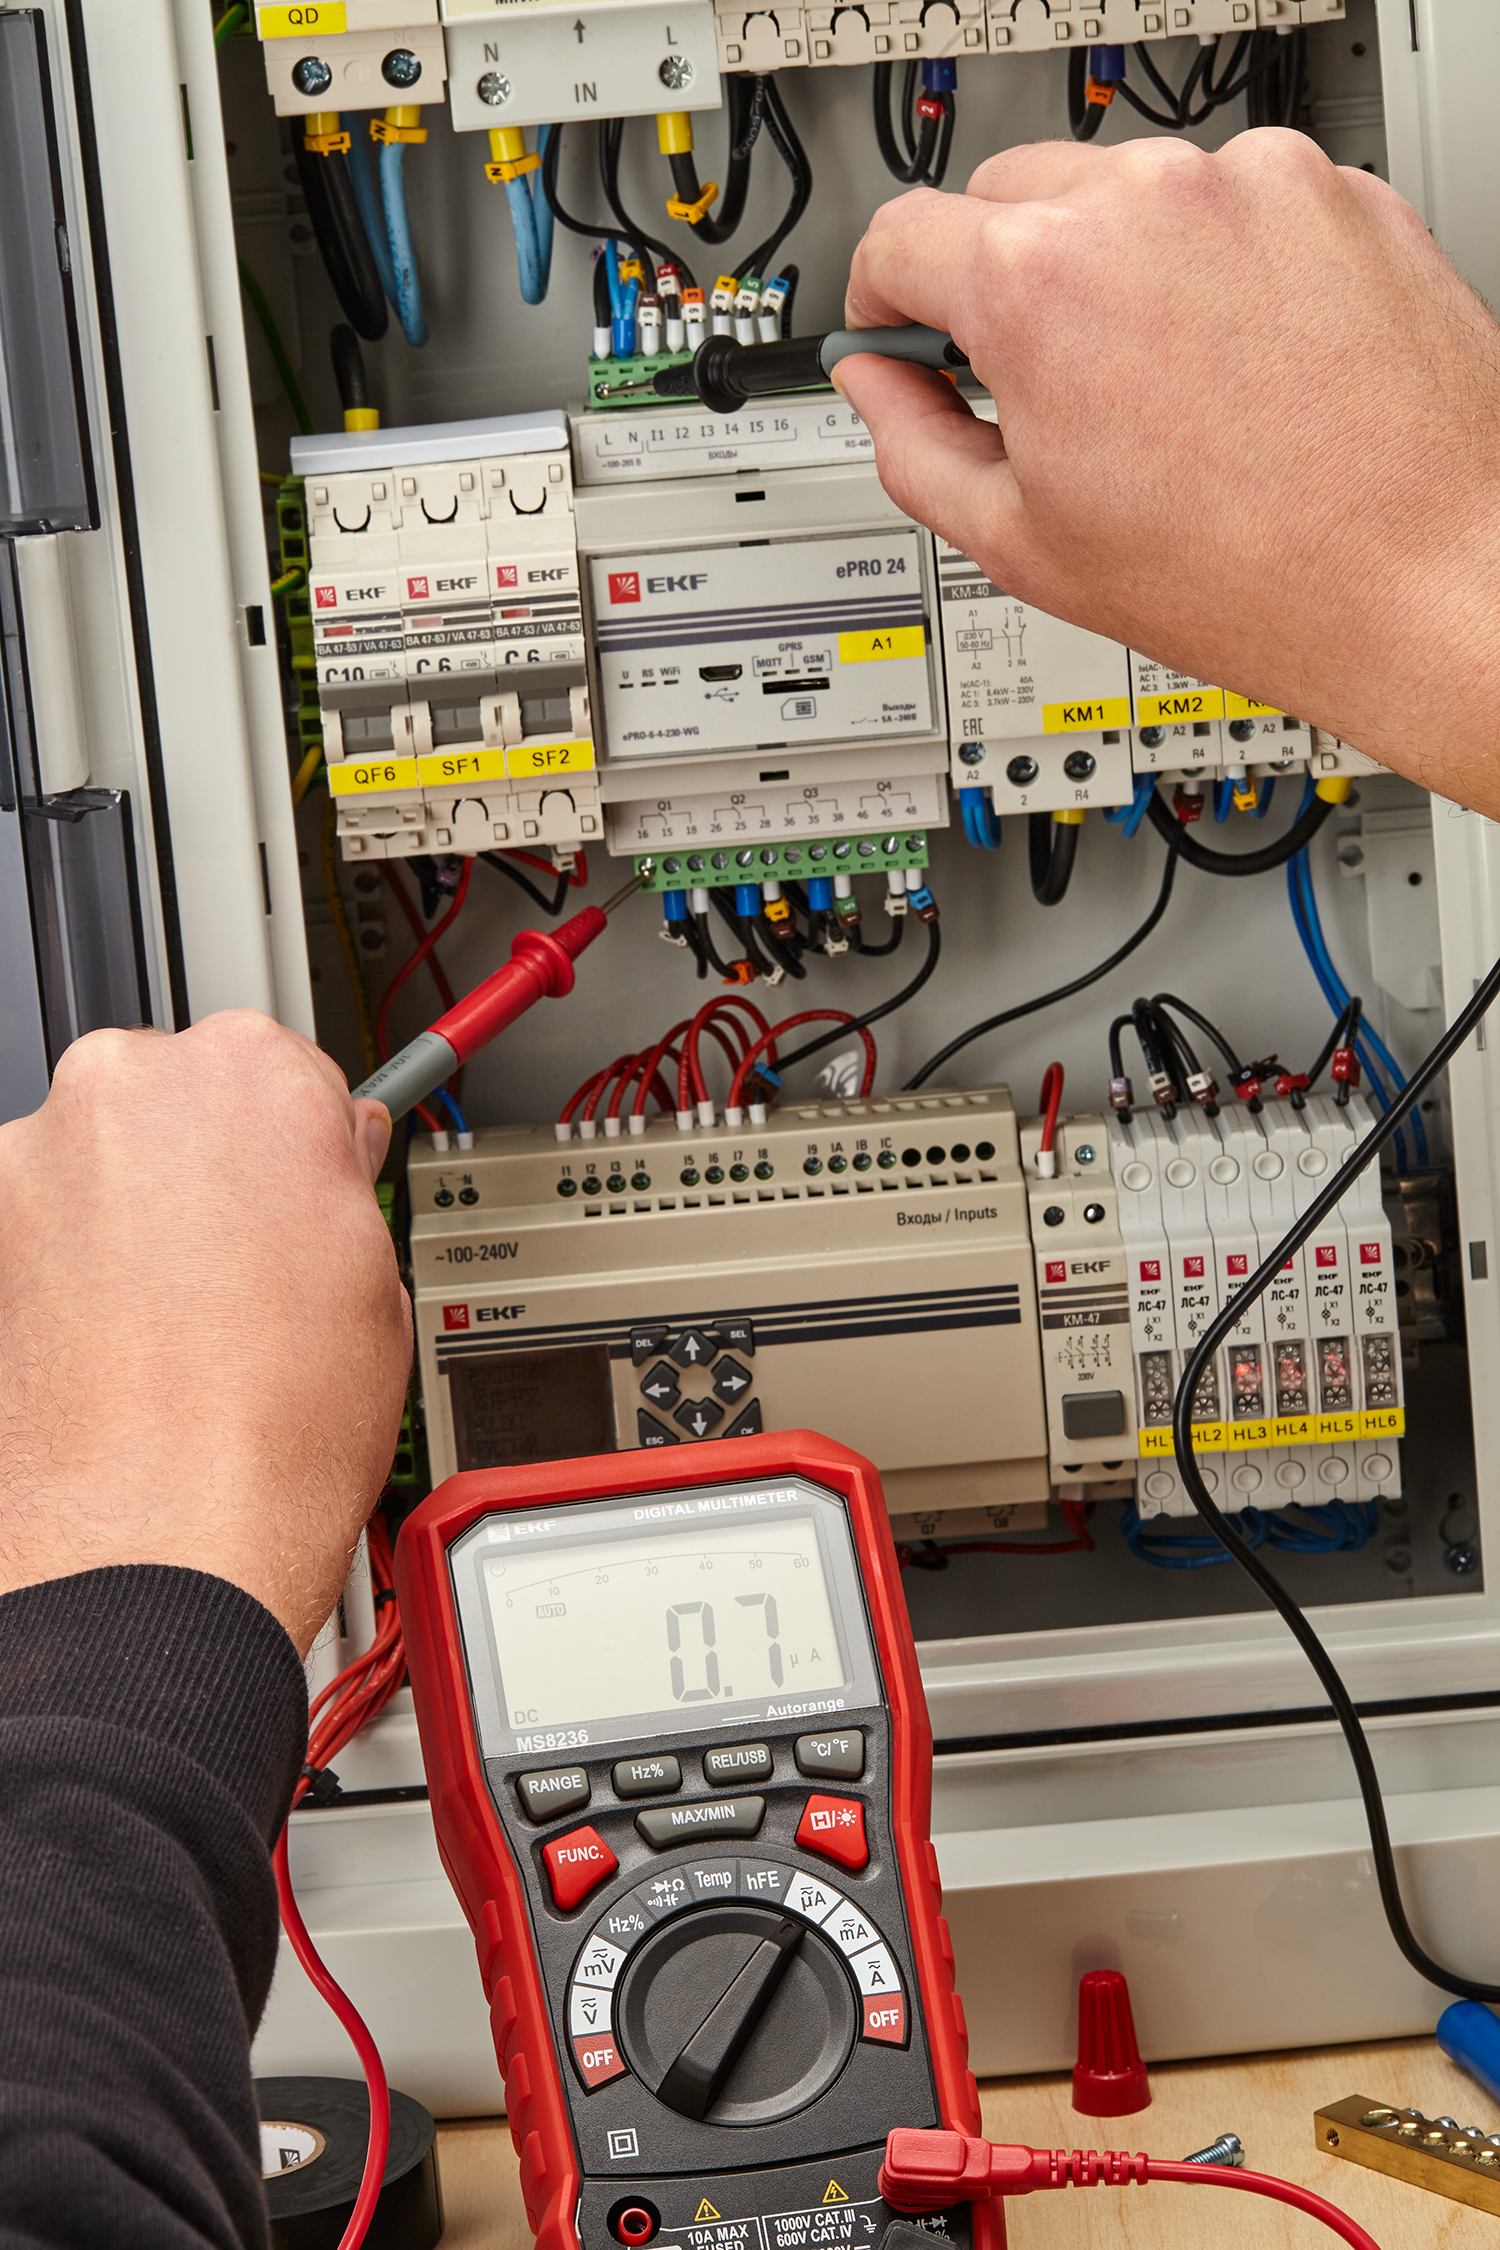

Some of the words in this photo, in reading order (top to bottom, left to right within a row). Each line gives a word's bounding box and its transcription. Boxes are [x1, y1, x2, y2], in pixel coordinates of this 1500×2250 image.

[288, 8, 319, 26] QD
[666, 26, 678, 45] L
[484, 43, 499, 62] N
[574, 83, 597, 102] IN
[826, 415, 836, 426] G
[605, 434, 612, 445] L
[629, 432, 638, 443] N
[527, 568, 570, 583] EKF
[836, 560, 882, 580] ePRO
[887, 558, 906, 576] 24
[436, 577, 478, 591] EKF
[646, 573, 708, 594] EKF
[345, 587, 386, 601] EKF
[951, 584, 989, 600] KM-40
[511, 625, 535, 636] 47-63
[542, 623, 555, 634] VA
[556, 620, 581, 632] 47-63
[422, 632, 446, 644] 47-63
[452, 631, 466, 641] VA
[467, 629, 491, 640] 47-63
[333, 642, 358, 654] 47-63
[364, 641, 377, 651] VA
[379, 639, 401, 650] 47-63
[778, 642, 803, 652] GPRS
[756, 658, 783, 668] MQTT
[803, 654, 825, 664] GSM
[642, 668, 654, 678] RS
[660, 666, 680, 677] WiFi
[1158, 697, 1203, 716] KM2
[1063, 705, 1104, 723] KM1
[1172, 726, 1186, 736] A2
[1262, 723, 1276, 734] A2
[532, 749, 571, 767] SF2
[1192, 749, 1205, 759] R4
[1281, 746, 1294, 757] R4
[442, 758, 481, 776] SF1
[354, 766, 396, 786] QF6
[966, 770, 980, 780] A2
[803, 788, 818, 799] Q3
[877, 781, 892, 792] Q4
[730, 794, 745, 805] Q2
[1075, 789, 1089, 801] R4
[657, 801, 672, 811] Q1
[881, 808, 893, 817] 45
[905, 806, 917, 815] 48
[784, 817, 795, 826] 36
[808, 815, 820, 824] 35
[832, 813, 844, 822] 38
[857, 810, 869, 819] 46
[686, 825, 697, 835] 18
[710, 823, 722, 833] 26
[734, 821, 747, 831] 25
[759, 819, 771, 829] 28
[637, 830, 649, 839] 16
[661, 828, 673, 837] 15
[463, 1174, 473, 1185] N
[897, 1208, 942, 1226] Входы
[954, 1205, 998, 1225] Inputs
[1071, 1260, 1111, 1275] EKF
[1273, 1277, 1294, 1285] EKF
[1317, 1273, 1338, 1281] EKF
[1361, 1271, 1382, 1279] EKF
[1184, 1284, 1204, 1292] EKF
[475, 1305, 526, 1322] EKF
[1063, 1312, 1101, 1327] KM-47
[730, 1329, 747, 1338] SEL
[635, 1338, 654, 1349] DEL
[1276, 1421, 1308, 1436] HL4
[1320, 1419, 1354, 1433] HL5
[1365, 1414, 1397, 1429] HL6
[1191, 1428, 1222, 1443] HL2
[1233, 1426, 1267, 1441] HL3
[645, 1436, 664, 1446] ESC
[634, 1501, 695, 1521] DIGITAL
[697, 1490, 799, 1513] MULTIMETER
[513, 1519, 557, 1536] EKF
[698, 1560, 713, 1571] 40
[748, 1558, 763, 1569] 50
[793, 1557, 810, 1569] 60
[644, 1565, 659, 1576] 30
[594, 1573, 610, 1585] 20
[547, 1585, 560, 1597] 10
[537, 1603, 565, 1618] AUTO
[666, 1593, 784, 1702] 0.7
[810, 1647, 821, 1662] A
[766, 1697, 845, 1718] Autorange
[514, 1708, 539, 1726] DC
[516, 1729, 589, 1752] MS8236
[711, 1749, 767, 1770] REL/USB
[631, 1763, 664, 1780] Hz%
[528, 1774, 582, 1794] RANGE
[671, 1805, 736, 1826] MAX/MIN
[557, 1843, 604, 1865] FUNC.
[694, 1870, 732, 1889] Temp
[746, 1870, 780, 1891] hFE
[608, 1913, 645, 1934] Hz%
[869, 2009, 900, 2028] OFF
[582, 2049, 614, 2068] OFF
[774, 2215, 811, 2233] 1000V
[815, 2208, 856, 2227] CAT.III
[687, 2230, 713, 2246] 10A
[717, 2224, 749, 2241] MAX
[777, 2230, 809, 2248] 600V
[811, 2224, 852, 2243] CAT.IV
